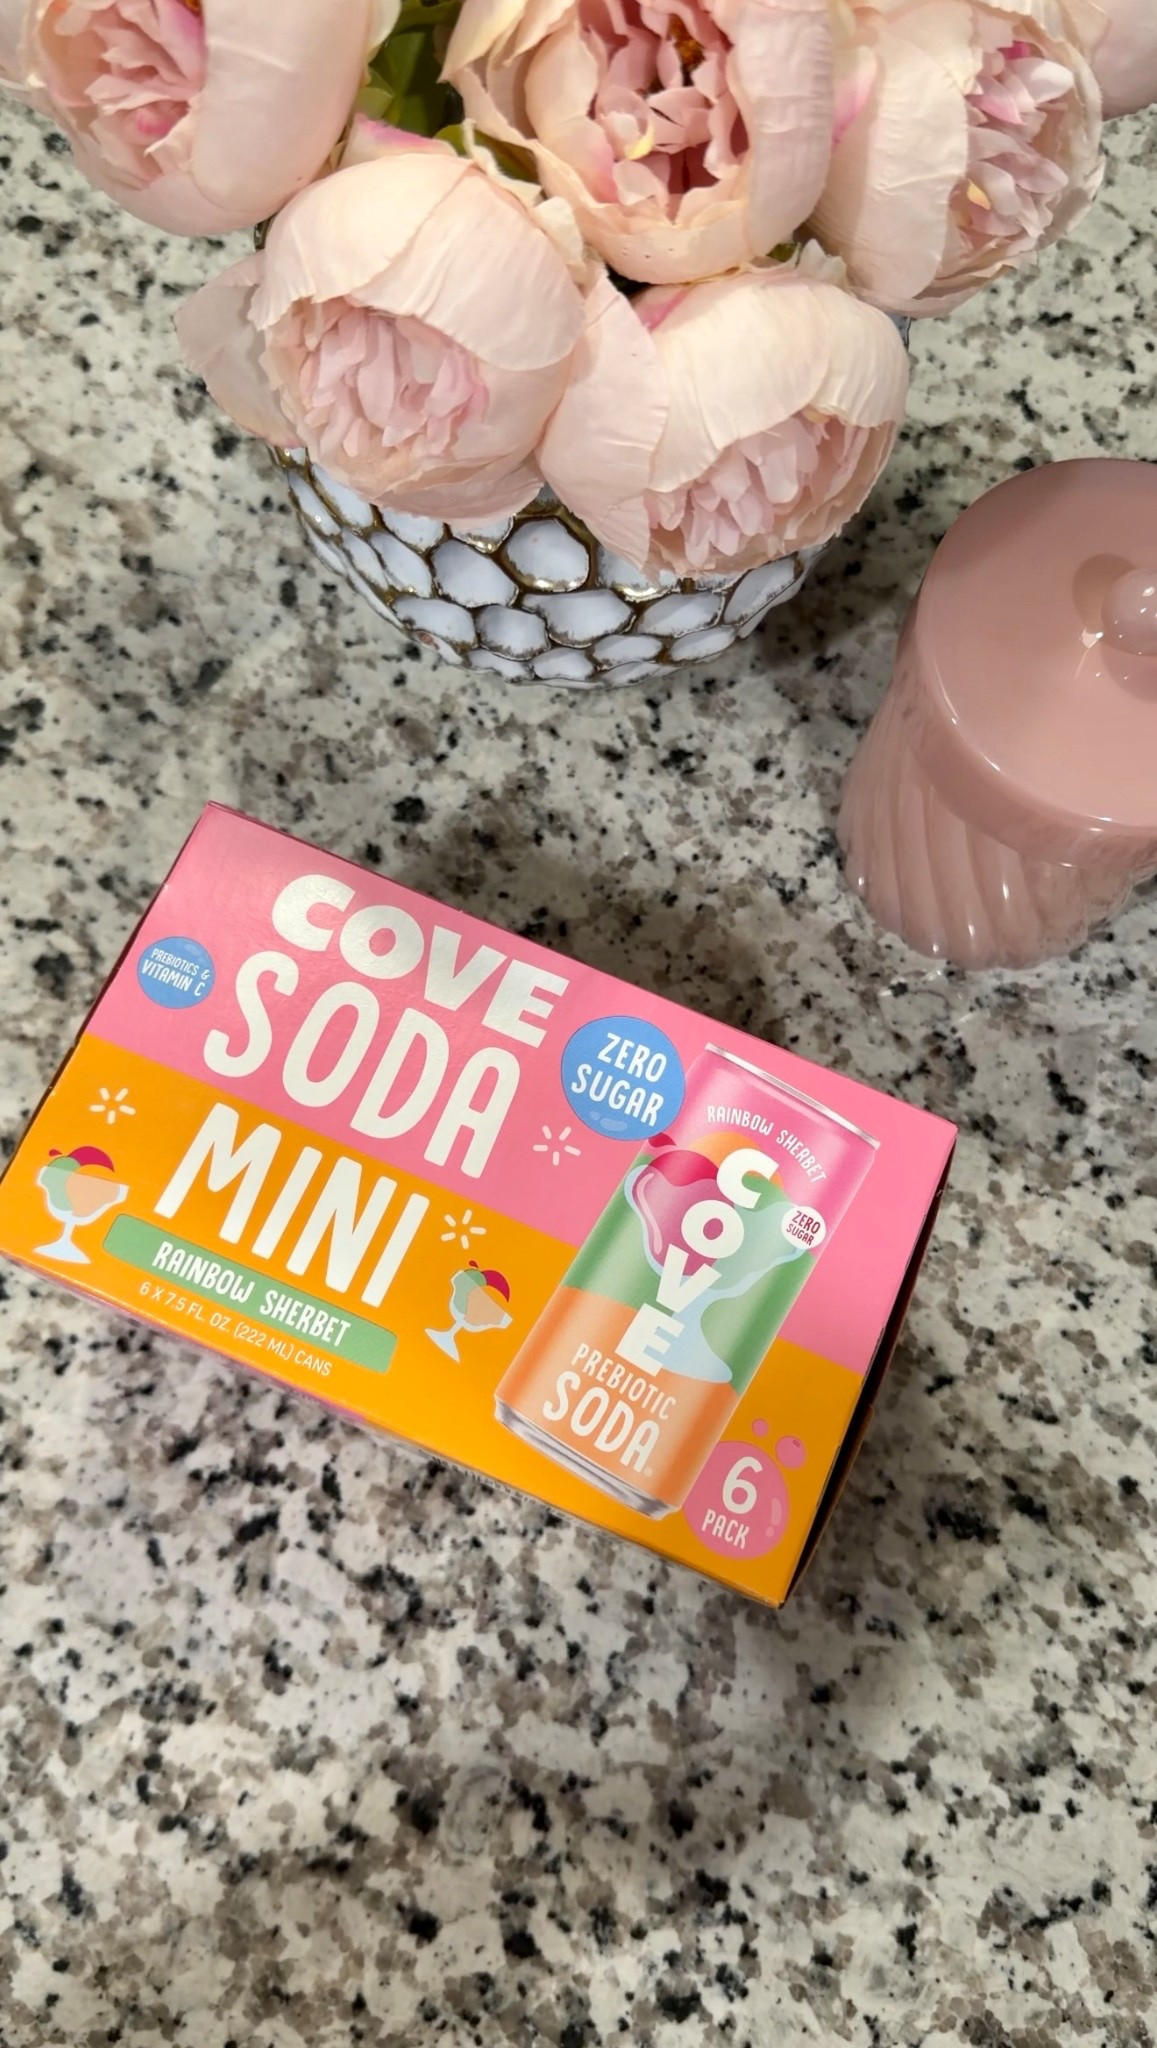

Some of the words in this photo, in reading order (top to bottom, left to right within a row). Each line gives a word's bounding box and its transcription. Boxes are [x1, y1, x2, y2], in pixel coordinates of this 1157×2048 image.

[141, 959, 193, 991] VITAMIN
[194, 981, 205, 996] C
[151, 948, 200, 976] PREBIOTICS
[201, 969, 210, 981] &
[272, 875, 569, 1048] COVE
[203, 951, 521, 1179] SODA
[597, 1032, 667, 1083] ZERO
[571, 1063, 664, 1127] SUGAR
[707, 1105, 774, 1136] RAINBOW
[776, 1129, 827, 1182] SHERBET
[153, 1102, 430, 1308] MINI
[786, 1223, 814, 1246] SUGAR
[791, 1210, 821, 1235] ZERO
[152, 1241, 255, 1303] RAINBOW
[259, 1290, 351, 1347] SHERBET
[139, 1281, 151, 1296] 6
[163, 1292, 186, 1312] 7.5
[209, 1312, 231, 1334] OZ.
[233, 1321, 268, 1347] (222
[266, 1338, 294, 1361] ML)
[294, 1350, 333, 1377] CANS
[571, 1342, 677, 1420] PREBIOTIC
[722, 1456, 763, 1515] 6
[701, 1508, 750, 1550] PACK
